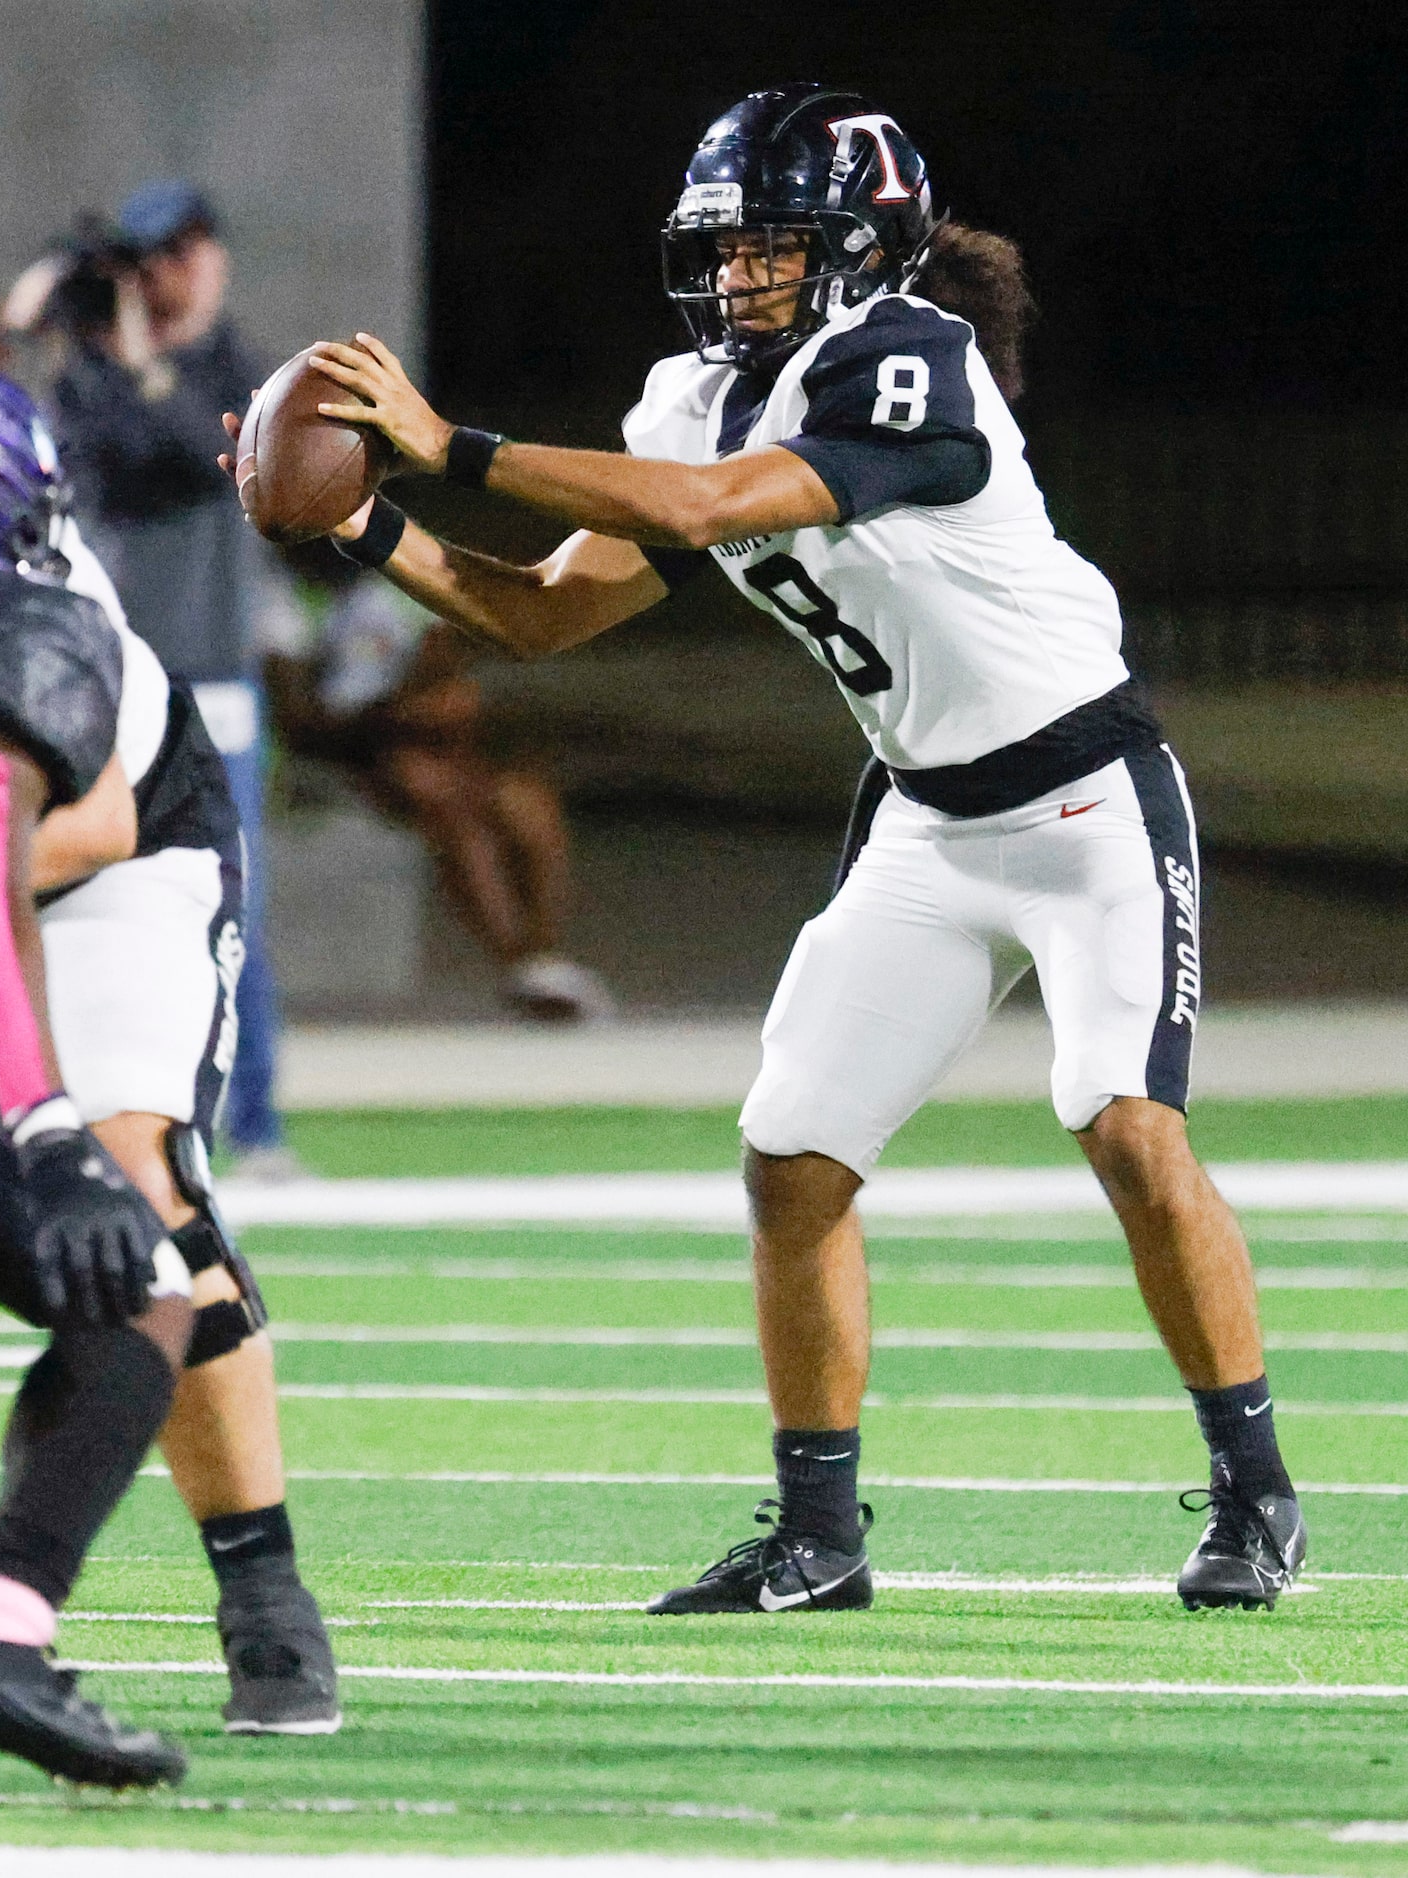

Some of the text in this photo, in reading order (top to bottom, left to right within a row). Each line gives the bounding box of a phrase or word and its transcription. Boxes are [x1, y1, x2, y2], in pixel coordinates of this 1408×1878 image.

[824, 112, 913, 203] T
[870, 354, 930, 433] 8
[742, 551, 893, 698] 8
